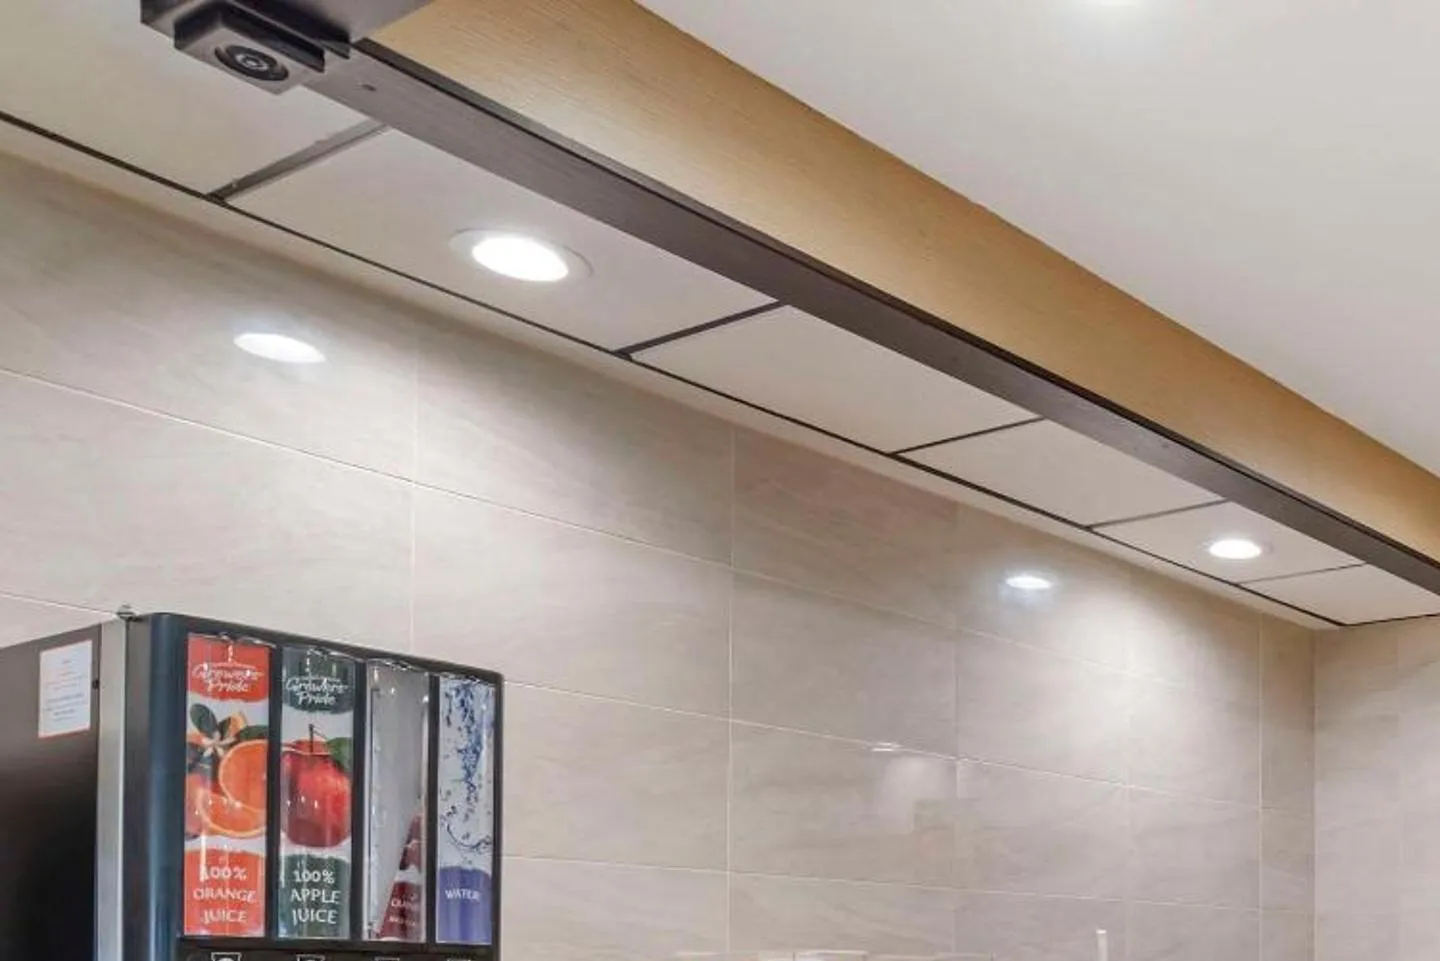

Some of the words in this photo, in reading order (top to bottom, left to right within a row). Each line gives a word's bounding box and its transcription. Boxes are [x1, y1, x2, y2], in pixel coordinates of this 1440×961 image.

[293, 869, 335, 884] 100%
[192, 888, 257, 904] ORANGE
[291, 888, 341, 904] APPLE
[444, 888, 480, 901] WATER
[202, 909, 248, 925] JUICE
[292, 909, 338, 925] JUICE
